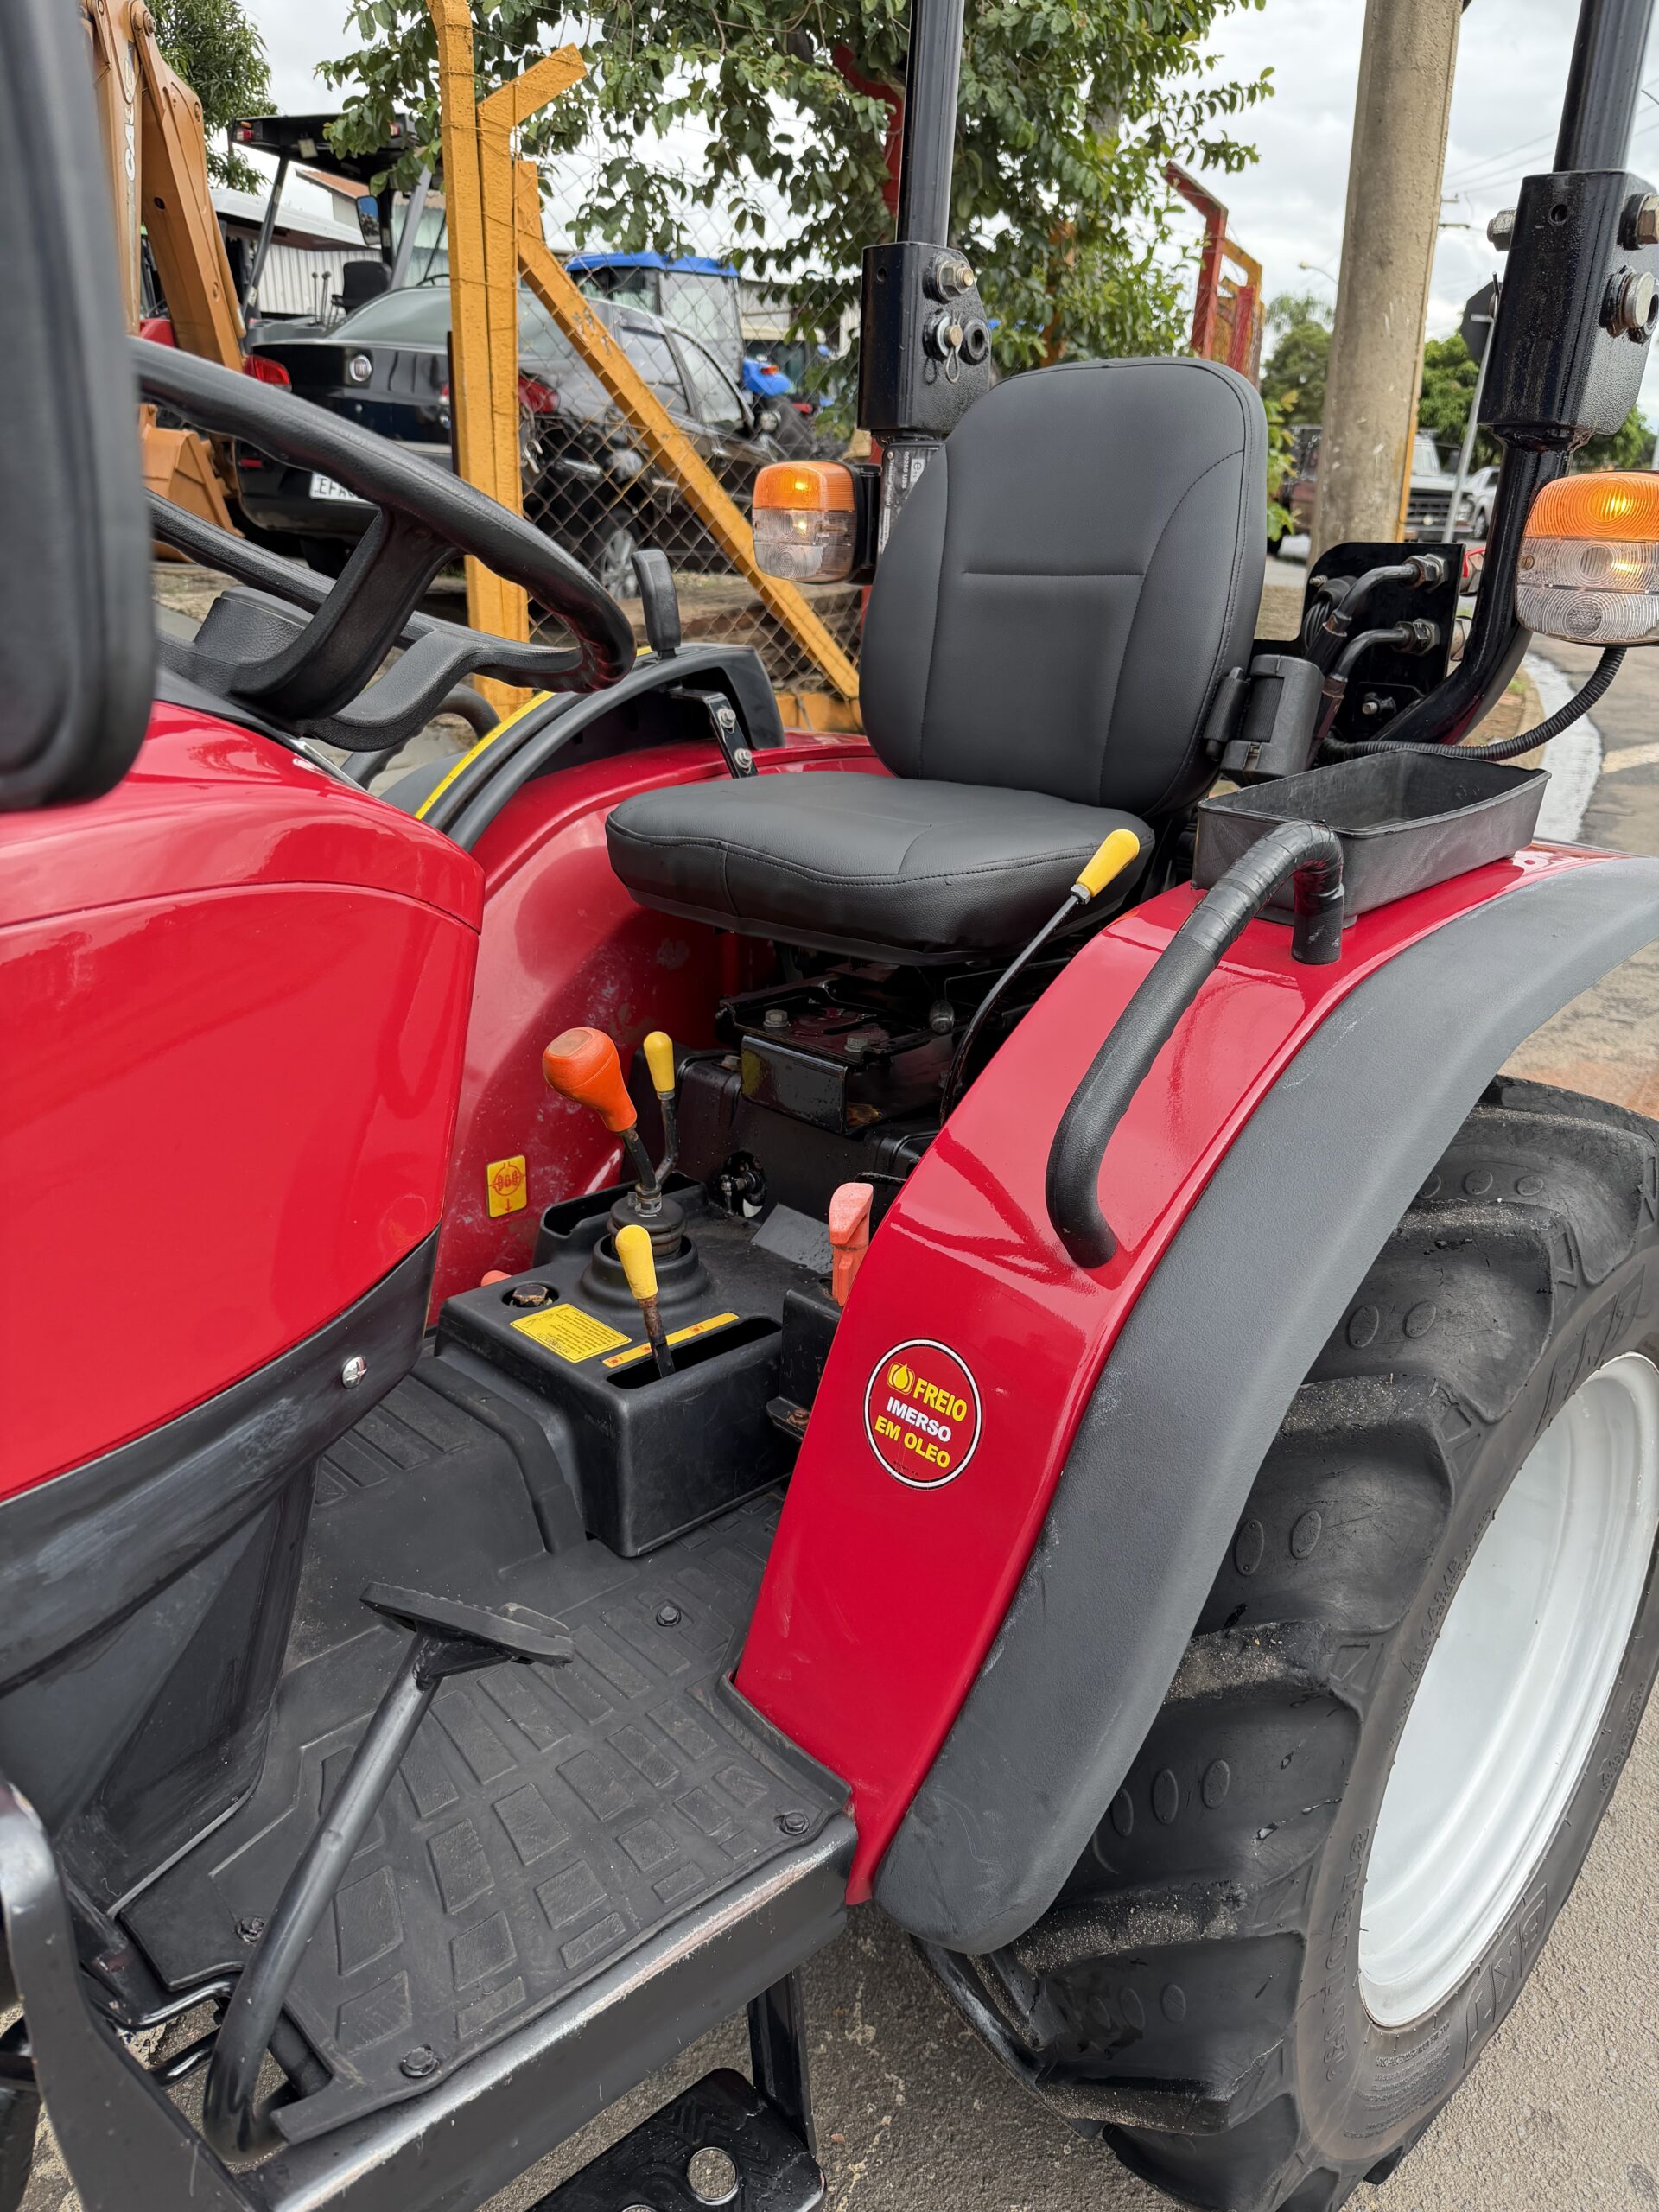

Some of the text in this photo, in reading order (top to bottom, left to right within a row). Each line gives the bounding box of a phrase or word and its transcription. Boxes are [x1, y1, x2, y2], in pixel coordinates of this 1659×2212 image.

[886, 1396, 952, 1442] IMERSO
[912, 1377, 968, 1422] FREIO
[874, 1414, 950, 1468] EM OLEO
